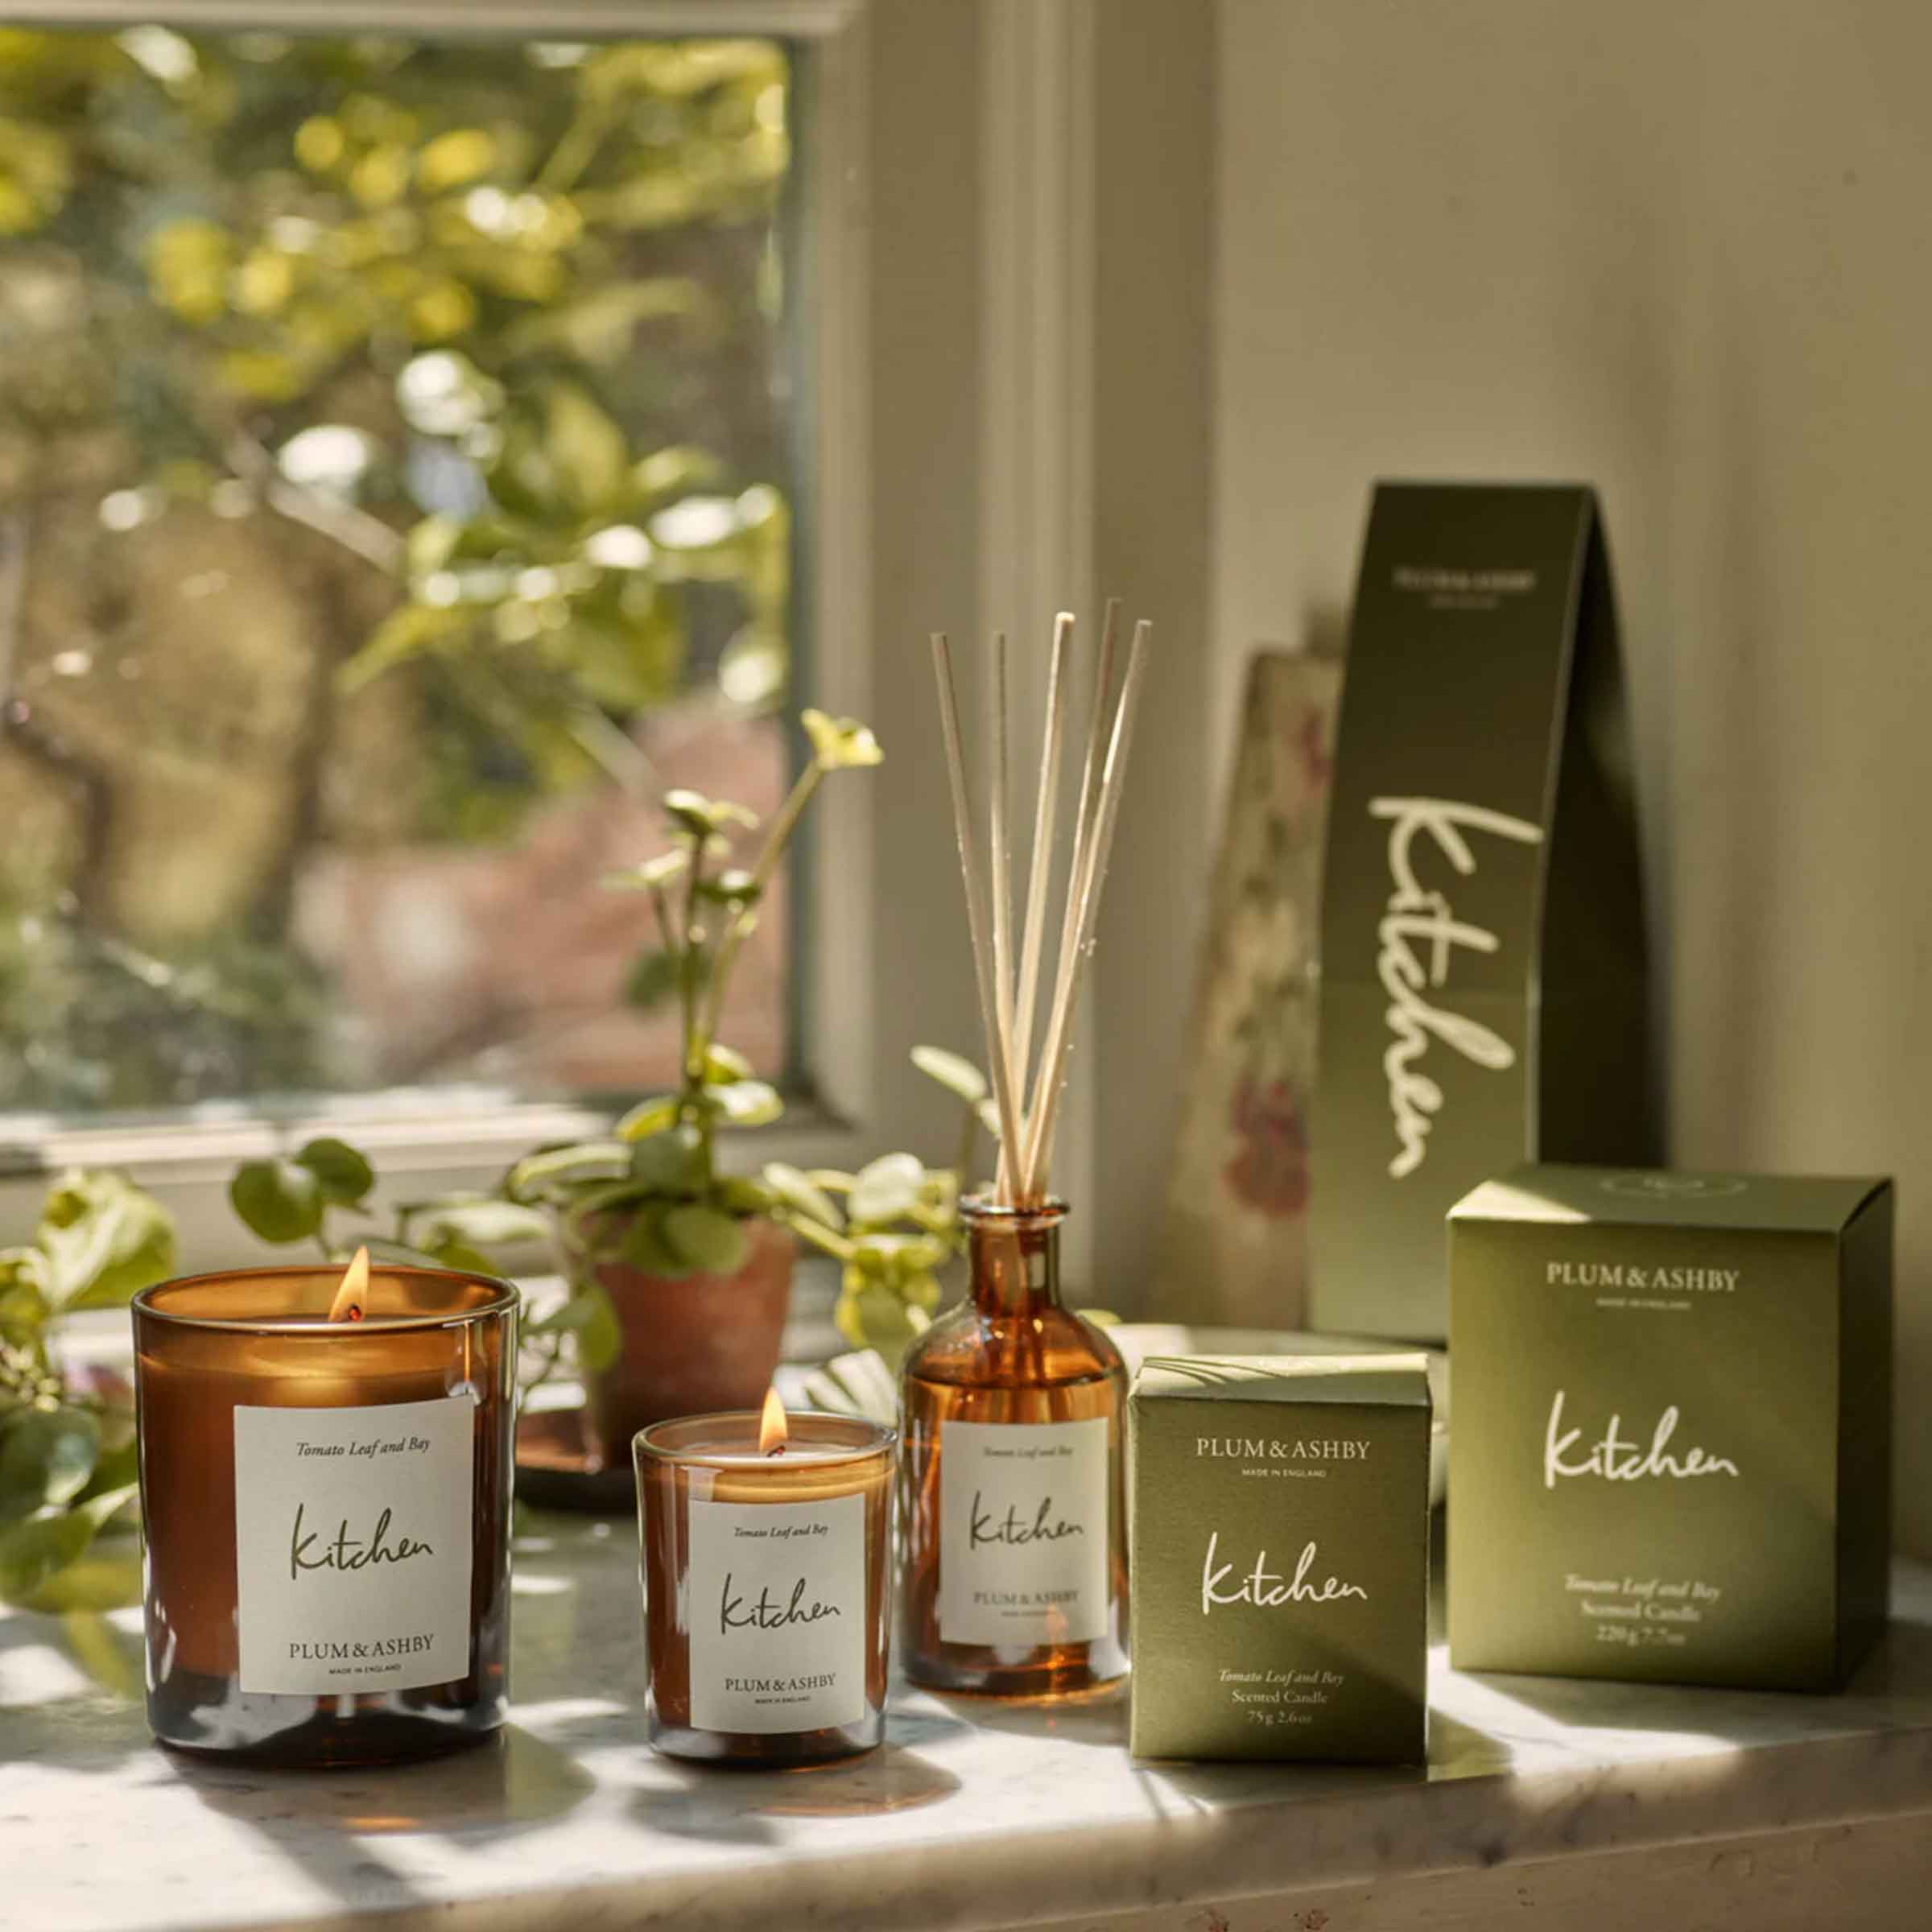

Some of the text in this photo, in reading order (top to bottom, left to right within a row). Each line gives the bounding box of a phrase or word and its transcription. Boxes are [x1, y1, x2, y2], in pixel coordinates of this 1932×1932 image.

[296, 1436, 431, 1459] Tomato Leaf and Bay
[1241, 1468, 1269, 1477] MADE
[1282, 1469, 1327, 1479] ENGLAND
[1218, 1668, 1346, 1688] Tomato Leaf and Bay
[1231, 1689, 1329, 1705] Scented Candle
